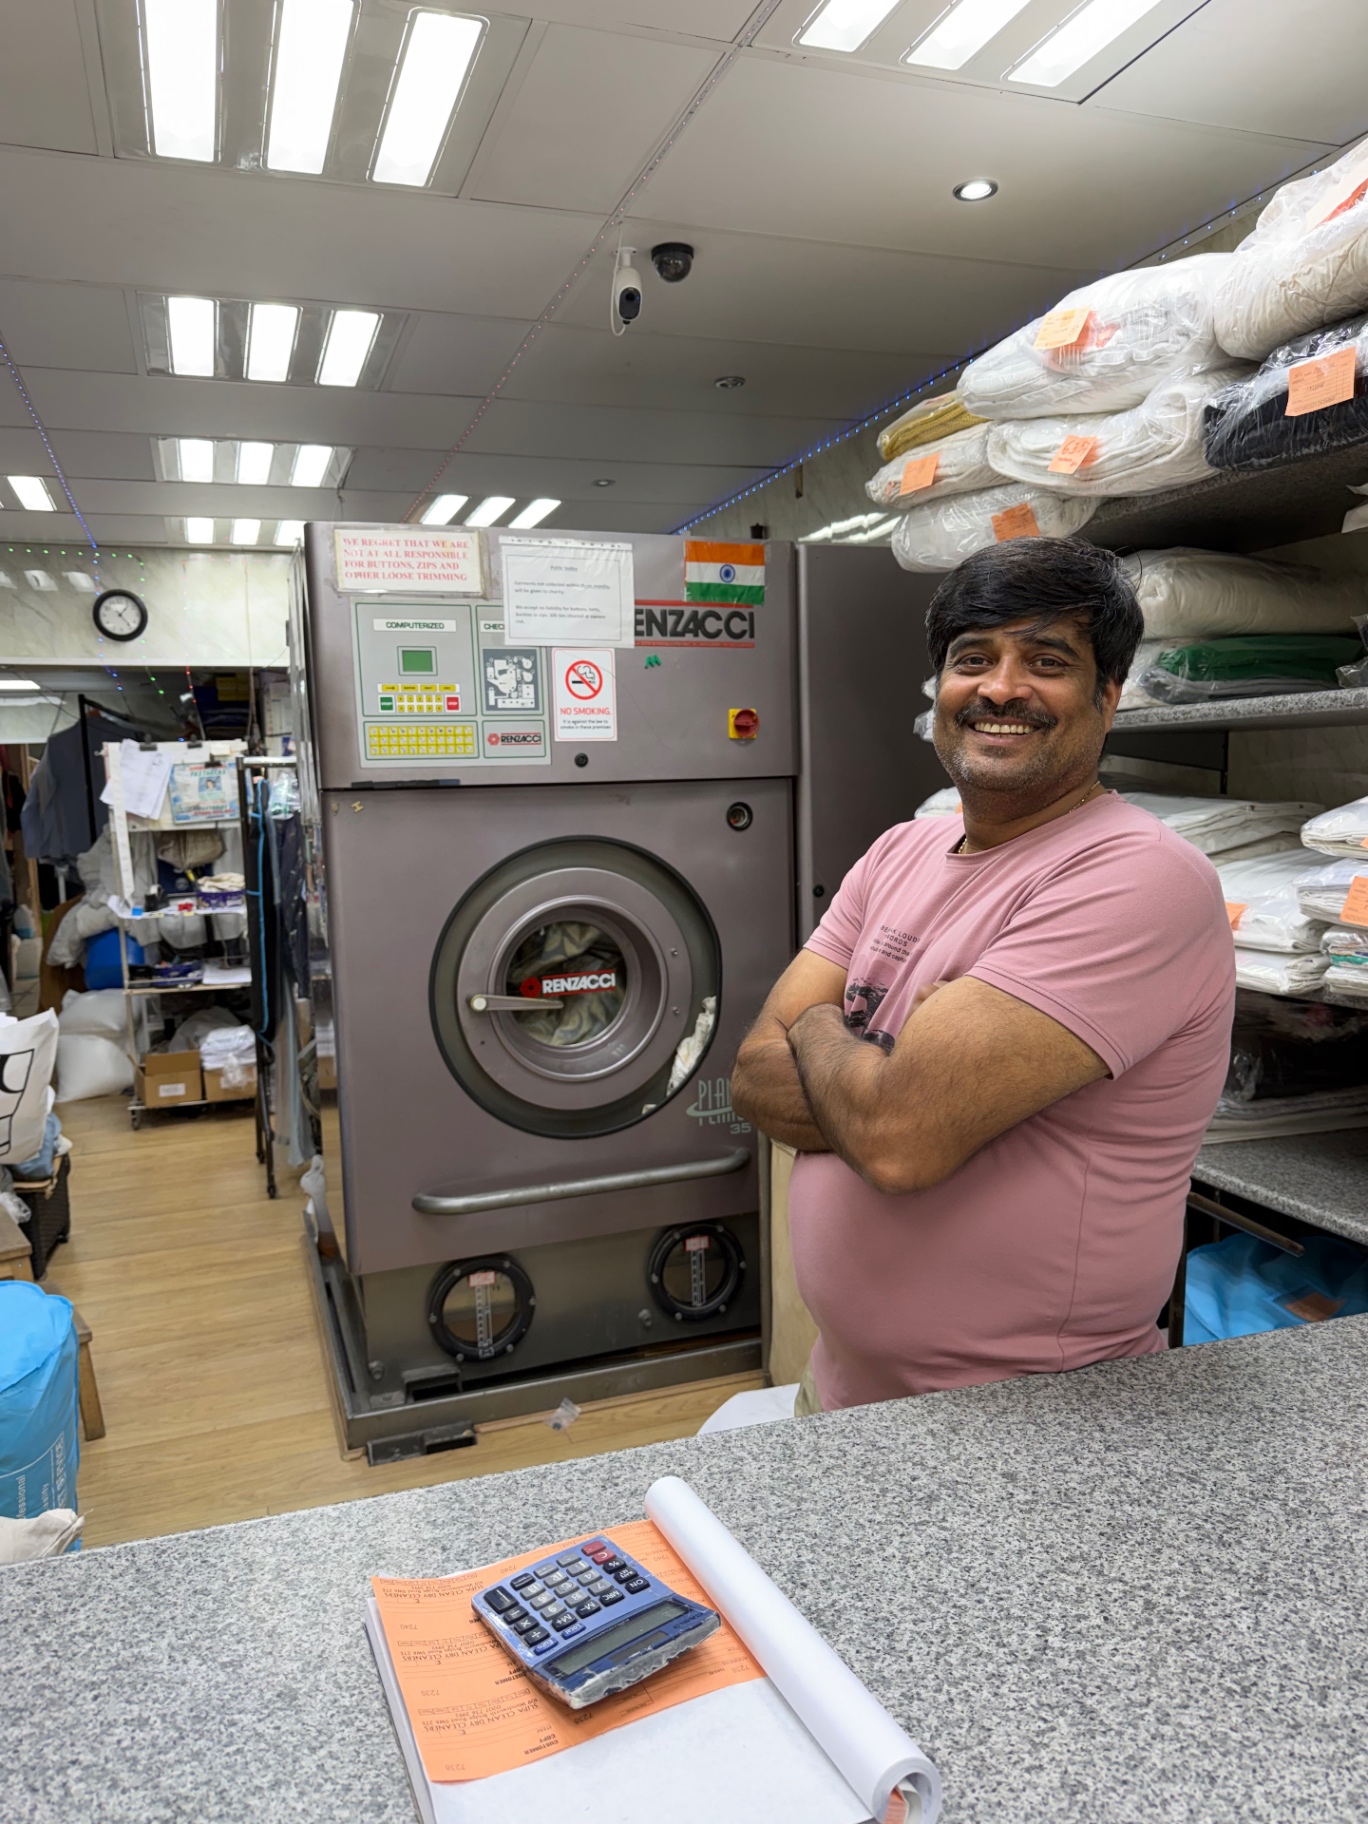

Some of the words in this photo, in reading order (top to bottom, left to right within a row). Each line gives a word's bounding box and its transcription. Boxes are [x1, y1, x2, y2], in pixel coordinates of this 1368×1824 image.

[343, 538, 359, 546] WE
[361, 538, 400, 547] REGRET
[403, 539, 429, 548] THAT
[432, 540, 448, 549] WE
[449, 541, 469, 549] ARE
[343, 549, 364, 557] NOT
[383, 550, 402, 558] ALL
[404, 550, 469, 560] RESPONSIBLE
[344, 560, 365, 568] FOR
[367, 561, 415, 570] BUTTONS,
[416, 561, 438, 570] ZIPS
[440, 562, 459, 570] AND
[345, 571, 379, 580] OTHER
[382, 571, 414, 580] LOOSE
[416, 572, 468, 581] TRIMMING
[385, 621, 445, 630] COMPUTERIZED
[483, 623, 505, 631] CHEC
[634, 608, 755, 640] ENZACCI
[560, 707, 572, 716] NO
[573, 707, 612, 716] SMOKING.
[500, 734, 542, 743] RENZACCI
[542, 972, 616, 994] RENZACCI
[730, 1122, 751, 1134] 35
[41, 1483, 50, 1511] uality
[500, 1565, 517, 1574] 7240
[597, 1582, 605, 1590] 7
[629, 1579, 644, 1588] ON
[439, 1589, 464, 1598] CLEAN
[571, 1593, 582, 1602] 8
[602, 1589, 620, 1601] MRC
[548, 1606, 557, 1614] 9
[555, 1613, 572, 1625] M+
[564, 1623, 582, 1635] Local
[537, 1637, 554, 1649] Euro
[463, 1646, 488, 1656] CLEAN
[402, 1653, 442, 1661] CLEANERS
[708, 1668, 725, 1676] NAME
[731, 1664, 751, 1674] 7238
[421, 1689, 440, 1697] 7239
[488, 1704, 502, 1712] 0207
[519, 1703, 539, 1714] SUPA
[466, 1712, 488, 1721] Bridge
[487, 1711, 516, 1724] CLEAN
[424, 1721, 467, 1732] CLEANERS
[469, 1719, 486, 1727] DRY
[536, 1724, 552, 1734] ITEM
[538, 1733, 556, 1743] COPY
[524, 1739, 559, 1755] CUSTOMER
[445, 1763, 466, 1771] 7238
